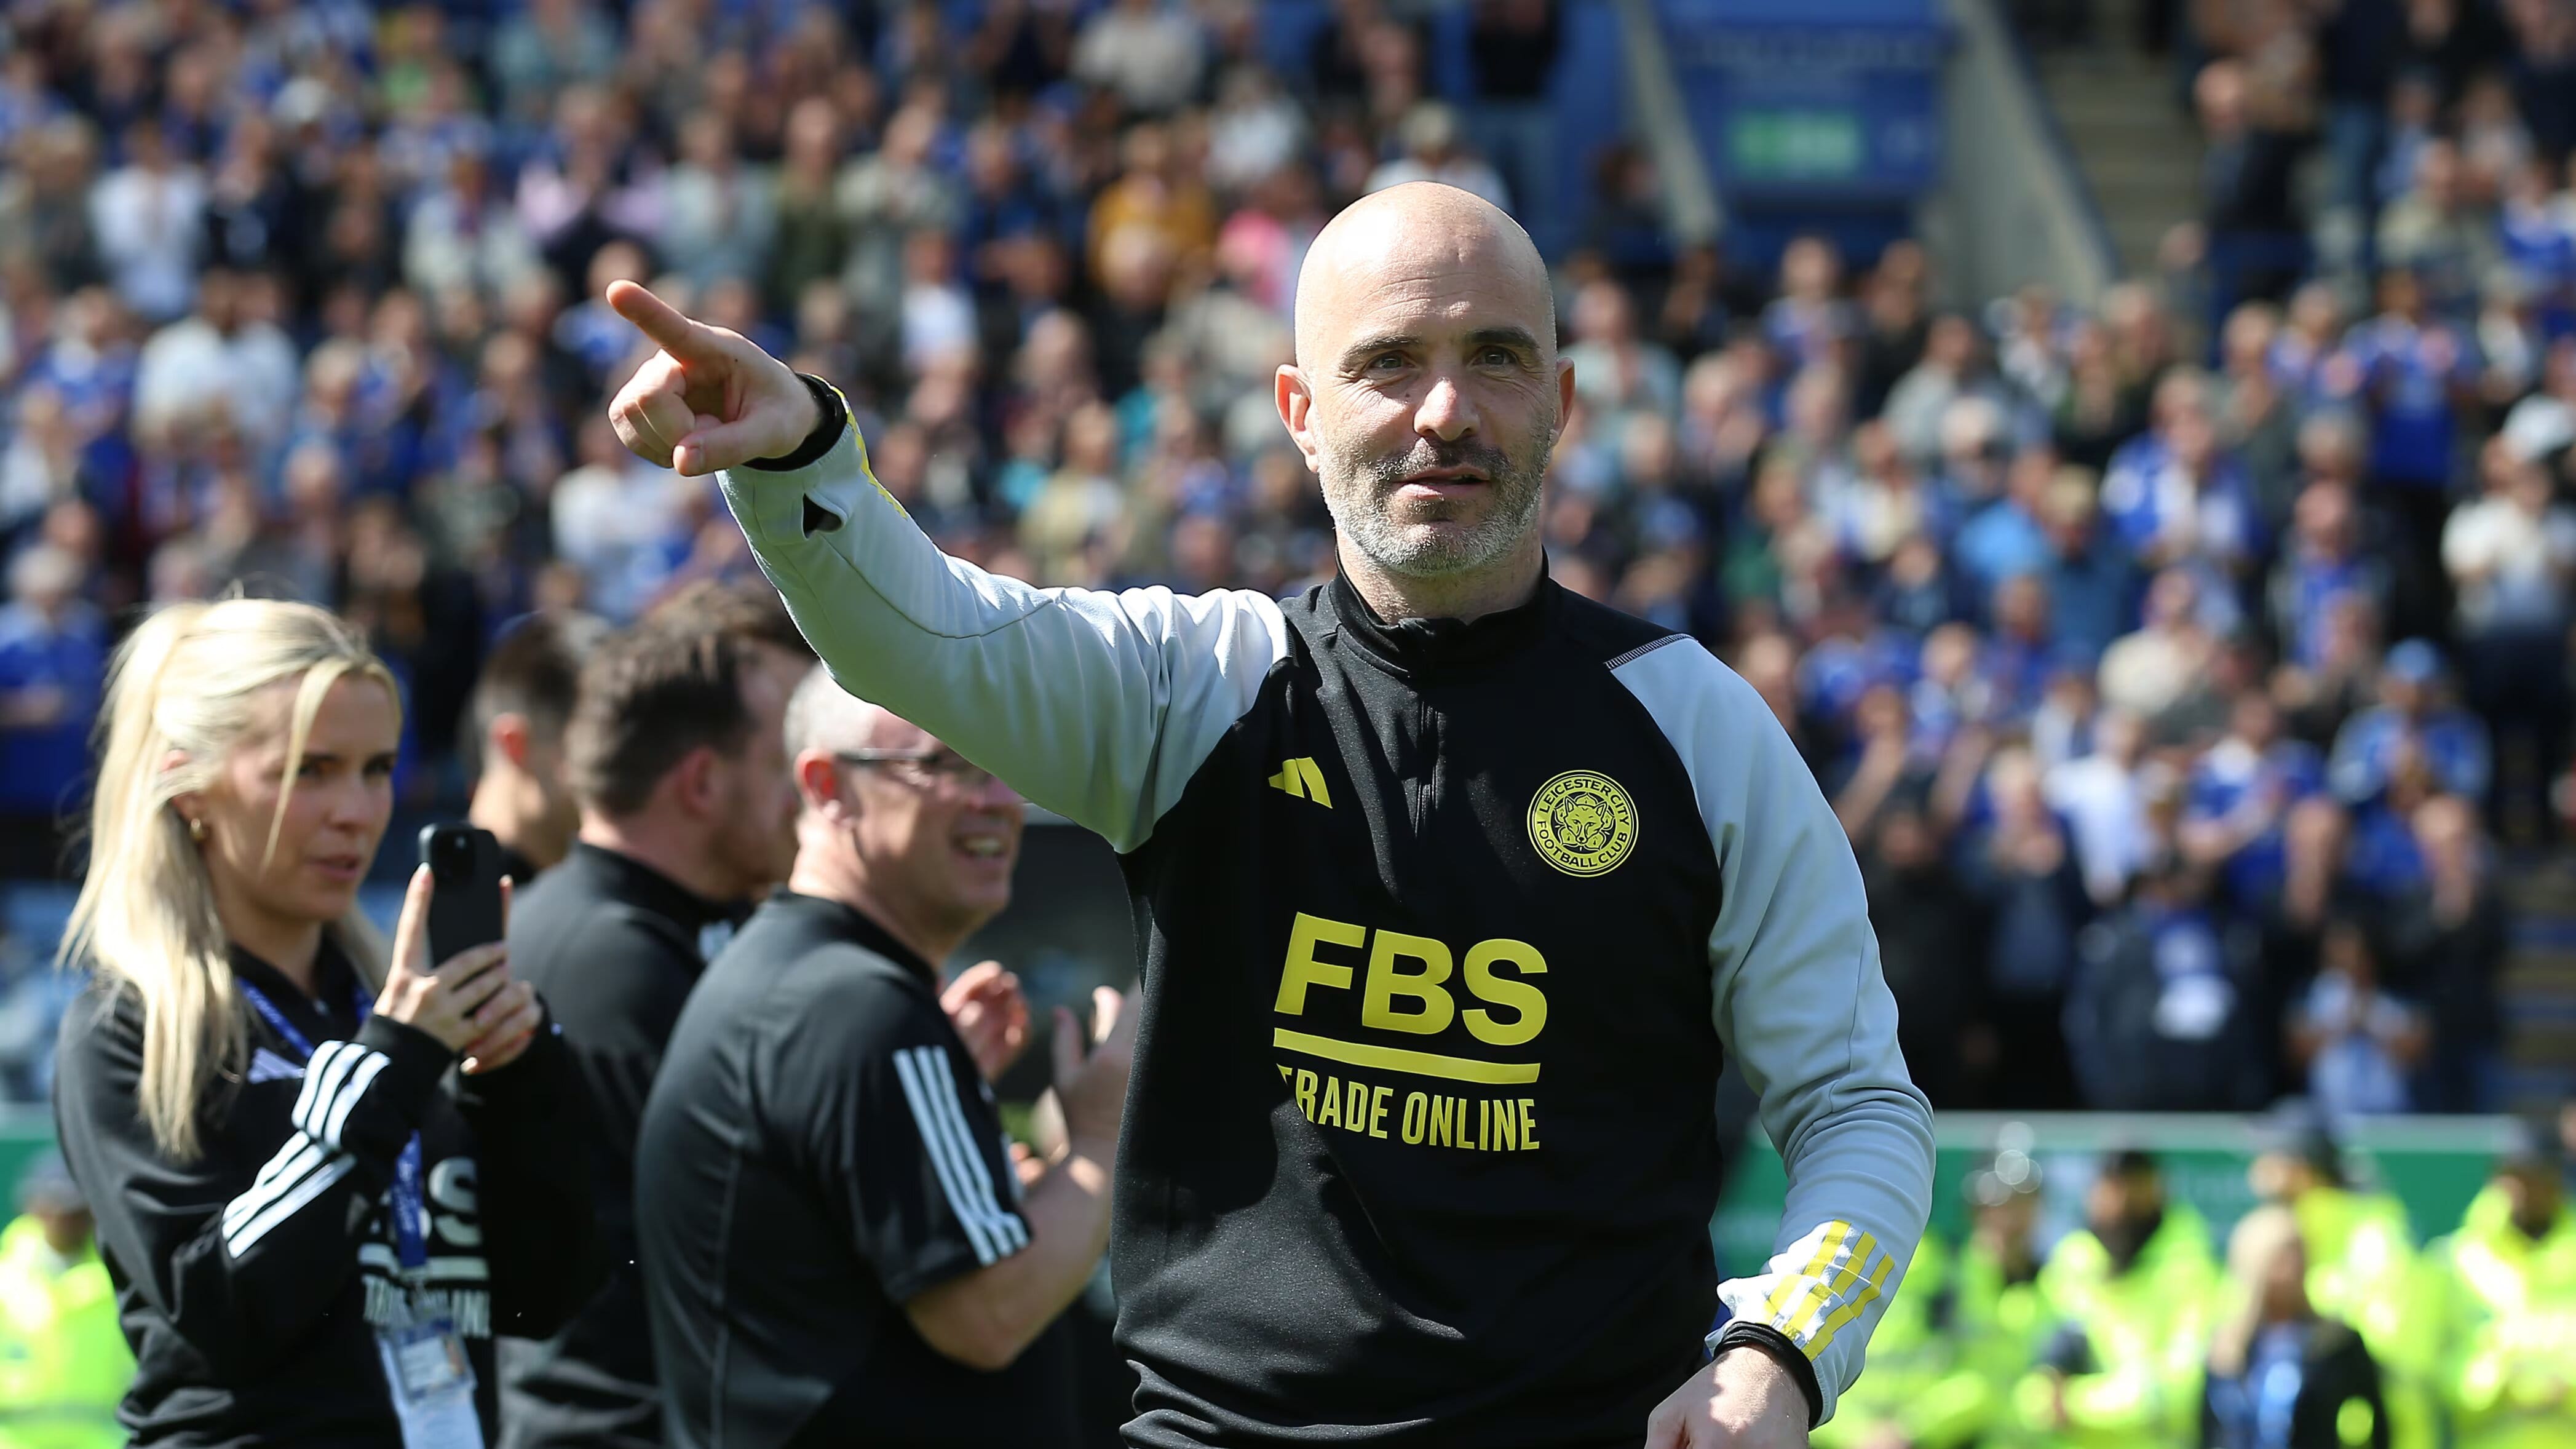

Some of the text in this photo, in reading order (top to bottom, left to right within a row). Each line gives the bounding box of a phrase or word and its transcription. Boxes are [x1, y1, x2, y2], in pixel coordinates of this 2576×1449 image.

[1539, 779, 1630, 826] LEICESTER CITY
[1537, 820, 1628, 868] FOOTBALL CLUB
[1274, 911, 1548, 1046] FBS
[1401, 1091, 1540, 1152] ONLINE
